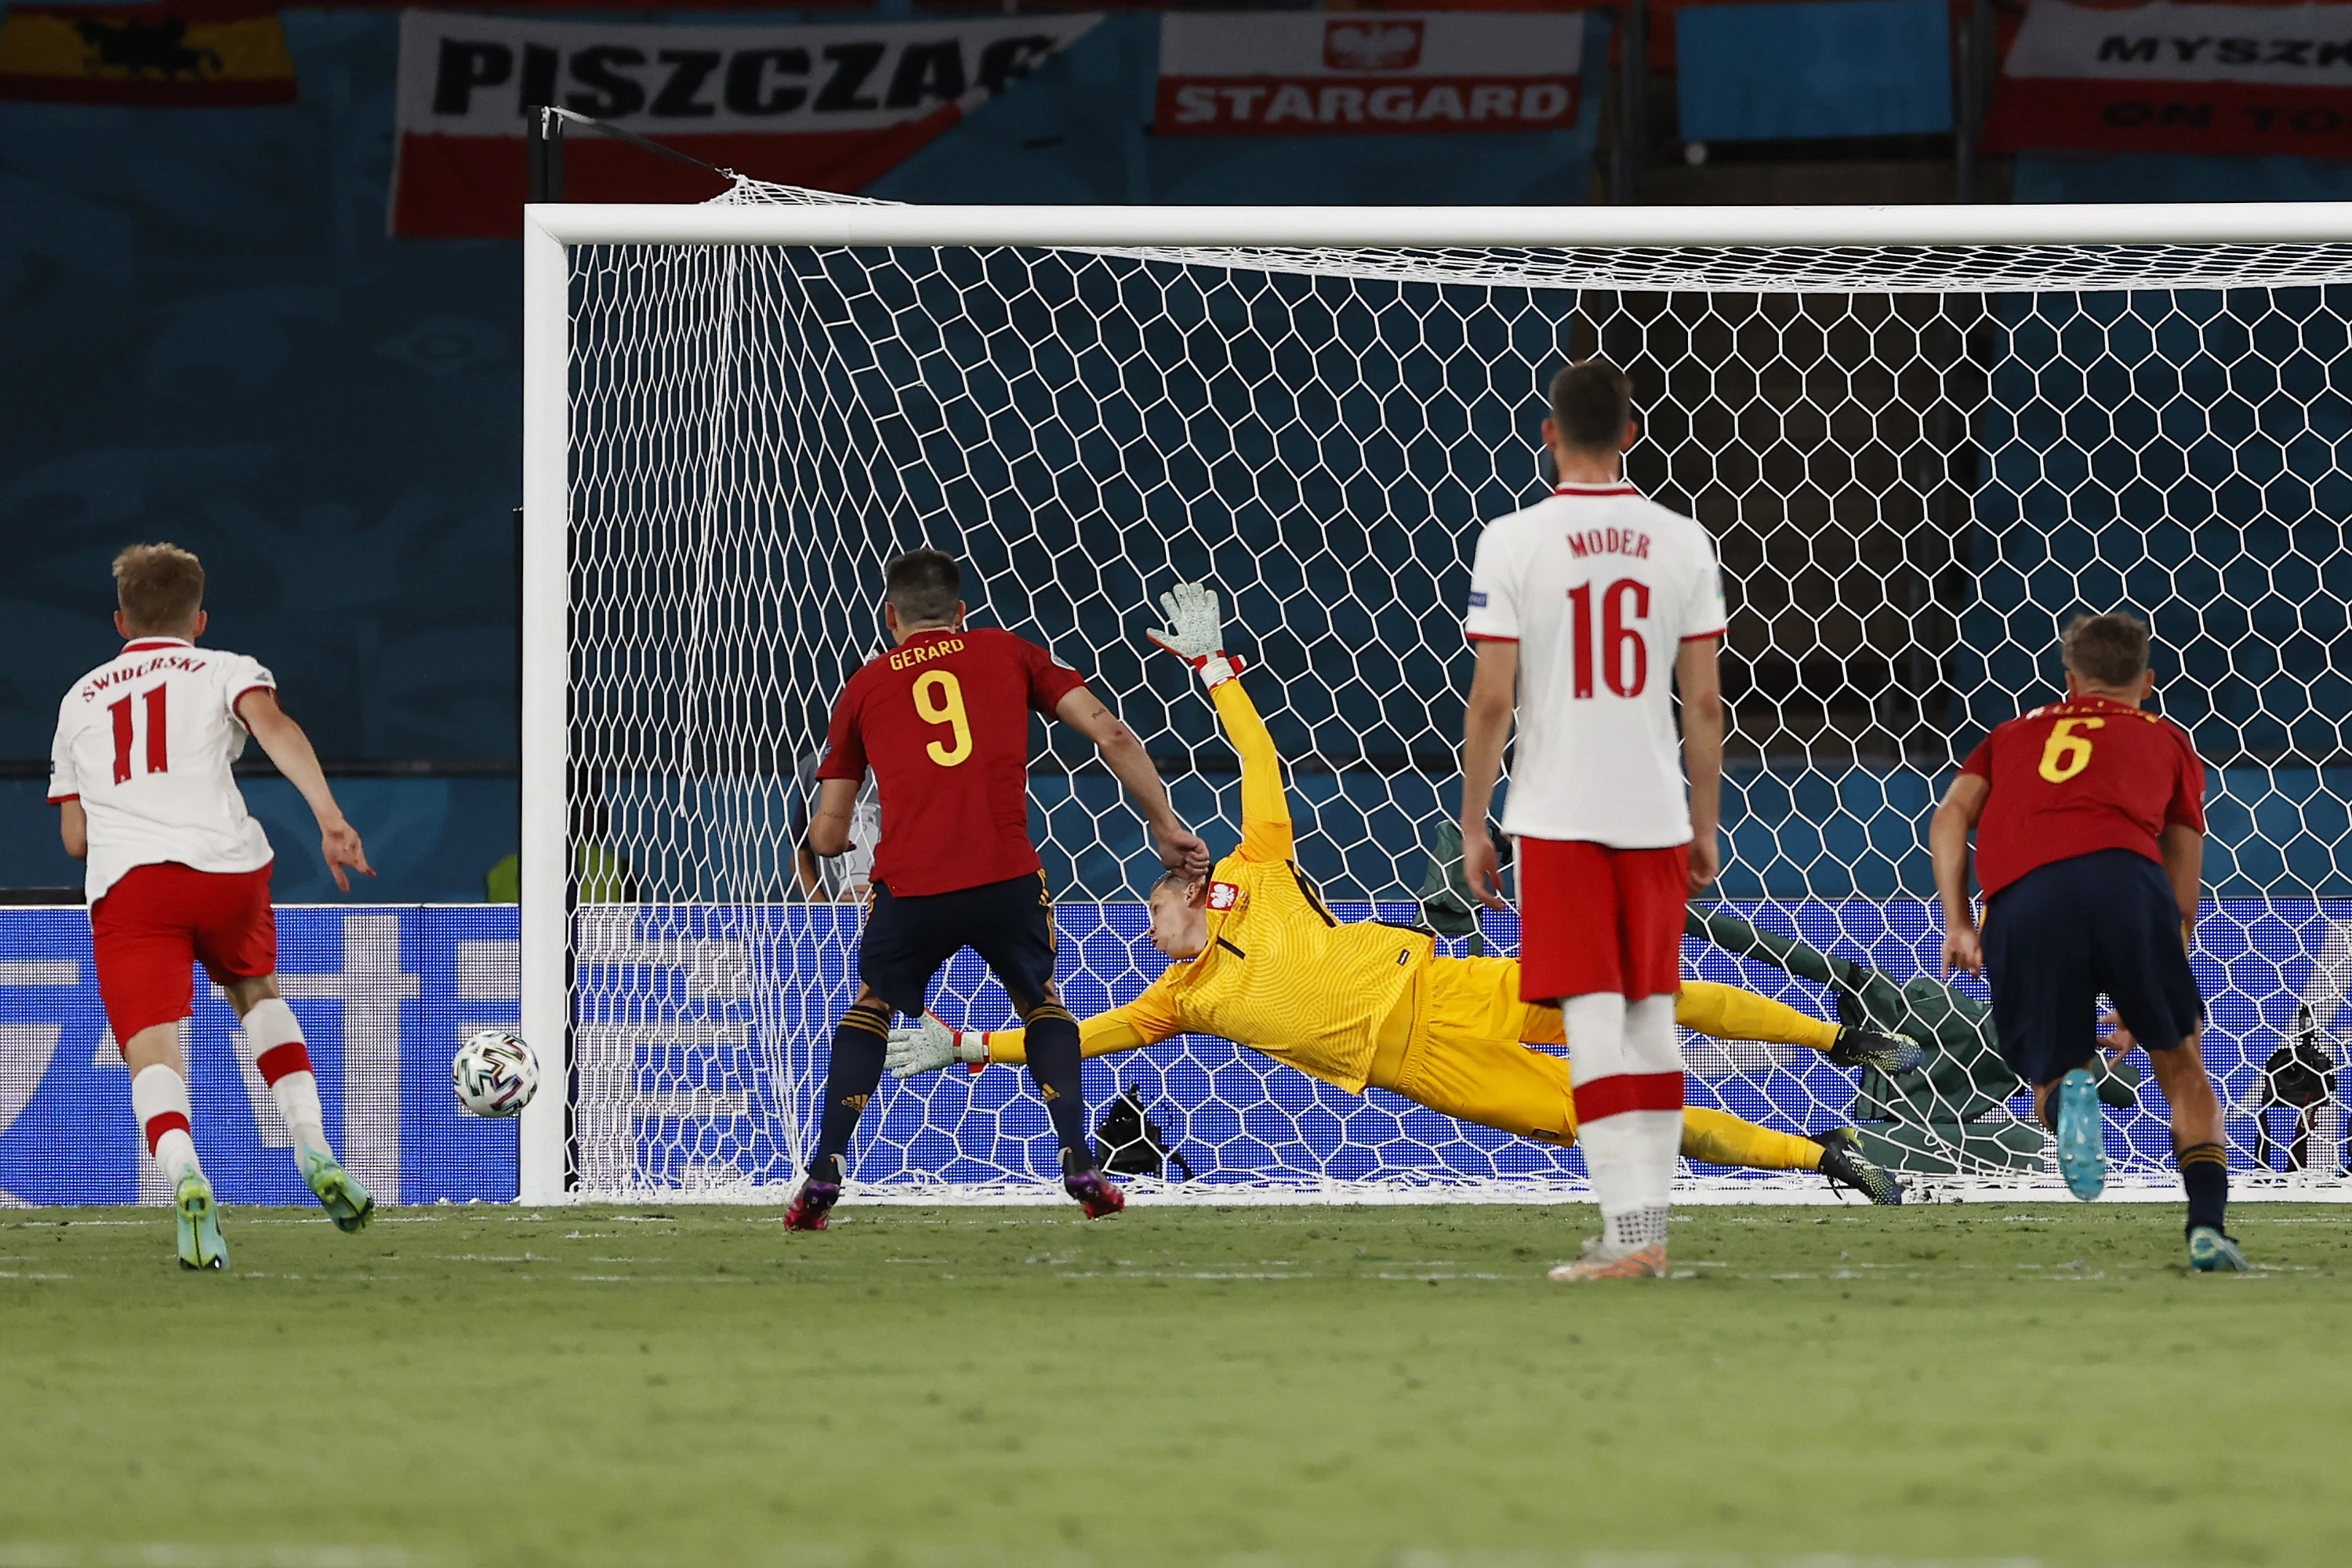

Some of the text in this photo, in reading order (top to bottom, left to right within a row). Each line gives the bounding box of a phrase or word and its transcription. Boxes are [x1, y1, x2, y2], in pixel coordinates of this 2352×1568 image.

[1176, 83, 1568, 123] STARGARD
[2101, 100, 2213, 128] ON
[1566, 528, 1650, 559] MODER
[890, 637, 964, 670] GERARD
[1566, 578, 1650, 699] 16
[107, 681, 168, 786] 11
[913, 670, 972, 767] 9
[2038, 717, 2105, 783] 6
